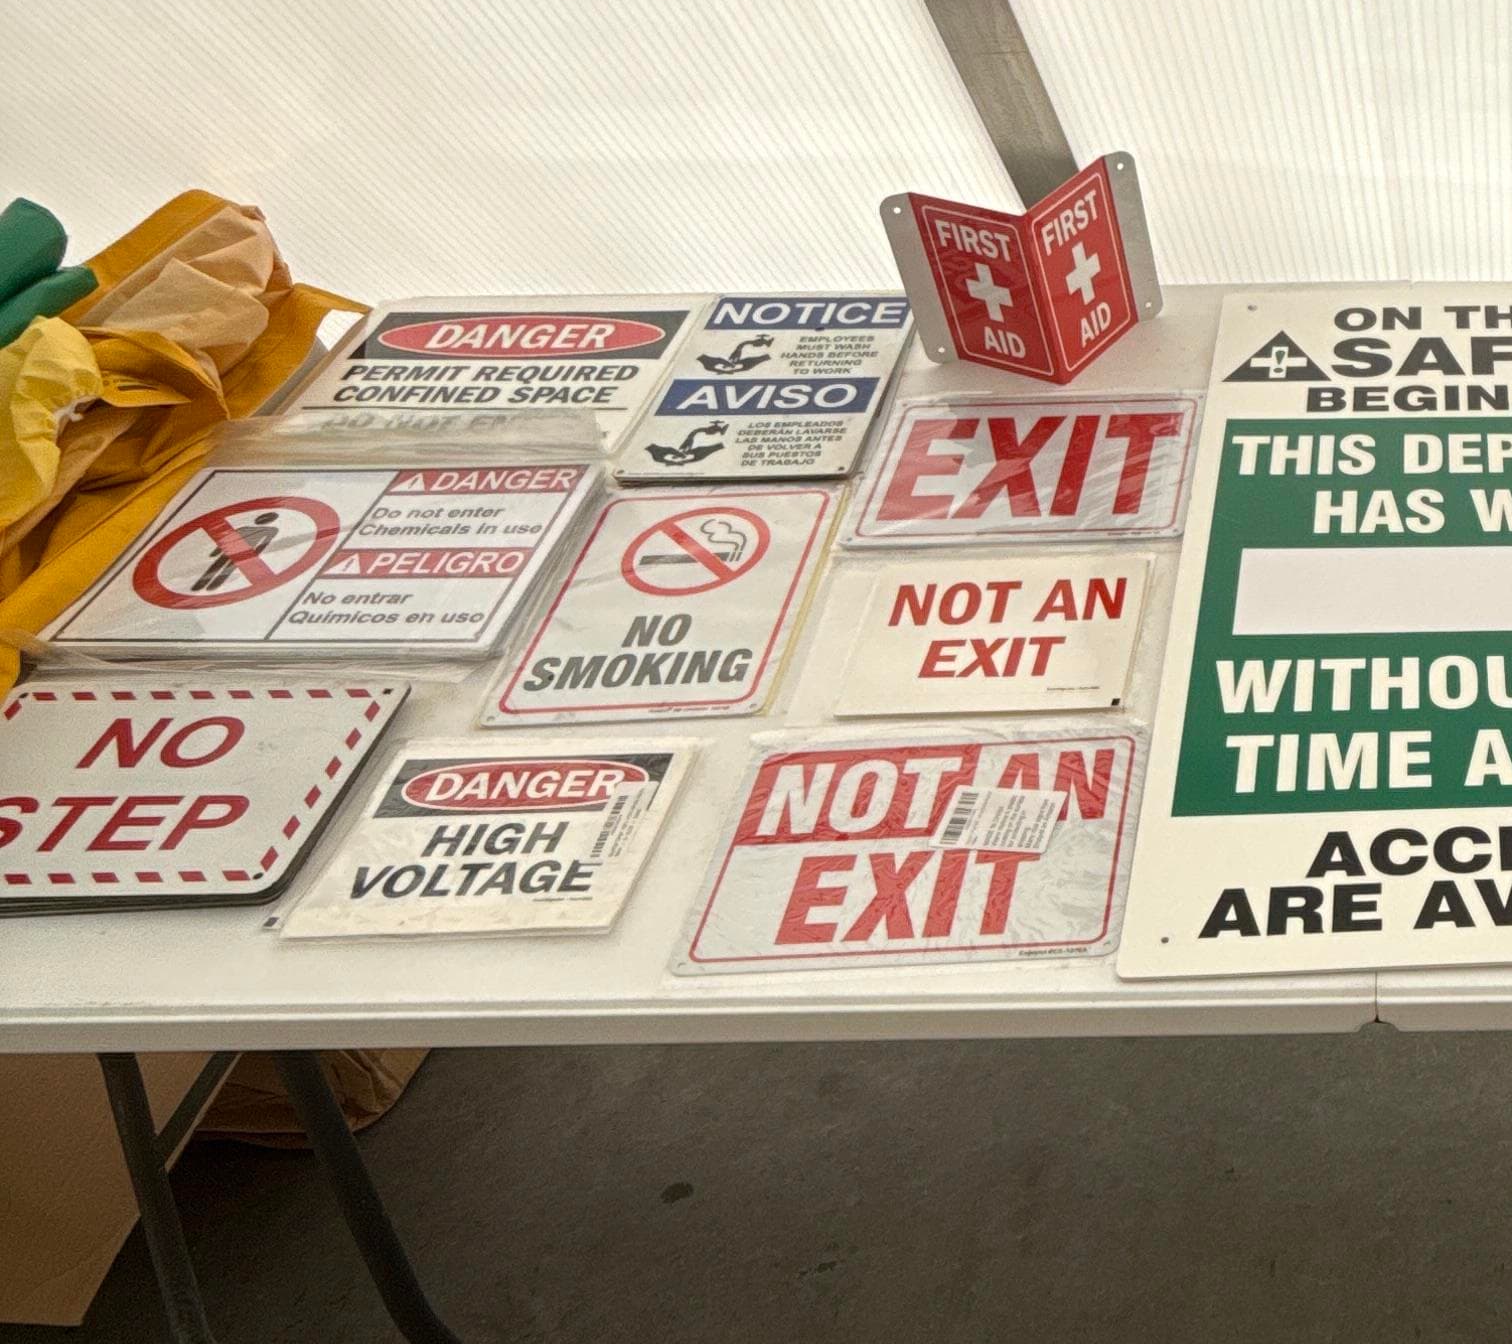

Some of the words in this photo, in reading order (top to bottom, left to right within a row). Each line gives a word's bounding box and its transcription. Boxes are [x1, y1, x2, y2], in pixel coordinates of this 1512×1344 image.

[1040, 190, 1098, 256] FIRST
[935, 220, 1011, 262] FIRST
[713, 302, 907, 325] NOTICE
[1079, 302, 1112, 348] AID
[1333, 306, 1422, 331] ON
[425, 324, 616, 350] DANGER
[799, 335, 875, 343] EMPLOYEES
[983, 327, 1026, 358] AID
[341, 365, 471, 381] PERMIT
[471, 365, 640, 382] REQUIRED
[789, 359, 862, 367] RETURNING
[813, 367, 852, 375] WORK
[333, 386, 507, 404] CONFINED
[509, 386, 619, 404] SPACE
[676, 384, 858, 410] AVISO
[875, 412, 1185, 521] EXIT
[1232, 434, 1377, 476] THIS
[429, 469, 578, 491] DANGER
[371, 507, 401, 519] Do
[407, 508, 443, 519] not
[448, 507, 504, 519] enter
[1312, 488, 1446, 535] HAS
[358, 523, 470, 536] Chemicals
[475, 523, 499, 535] in
[502, 524, 543, 535] use
[366, 551, 526, 574] PELIGRO
[301, 592, 337, 605] No
[340, 593, 413, 604] entrar
[888, 580, 1023, 626] NOT
[1033, 577, 1128, 622] AN
[287, 610, 398, 625] Químicos
[402, 612, 435, 624] en
[439, 612, 485, 624] uso
[621, 613, 692, 648] NO
[523, 648, 753, 692] SMOKING
[917, 636, 1066, 678] EXIT
[75, 716, 245, 768] NO
[1225, 728, 1433, 793] TIME
[425, 769, 626, 802] DANGER
[756, 756, 963, 836] NOT
[420, 821, 569, 857] HIGH
[350, 859, 603, 899] VOLTAGE
[774, 852, 1041, 945] EXIT
[1198, 883, 1384, 938] ARE
